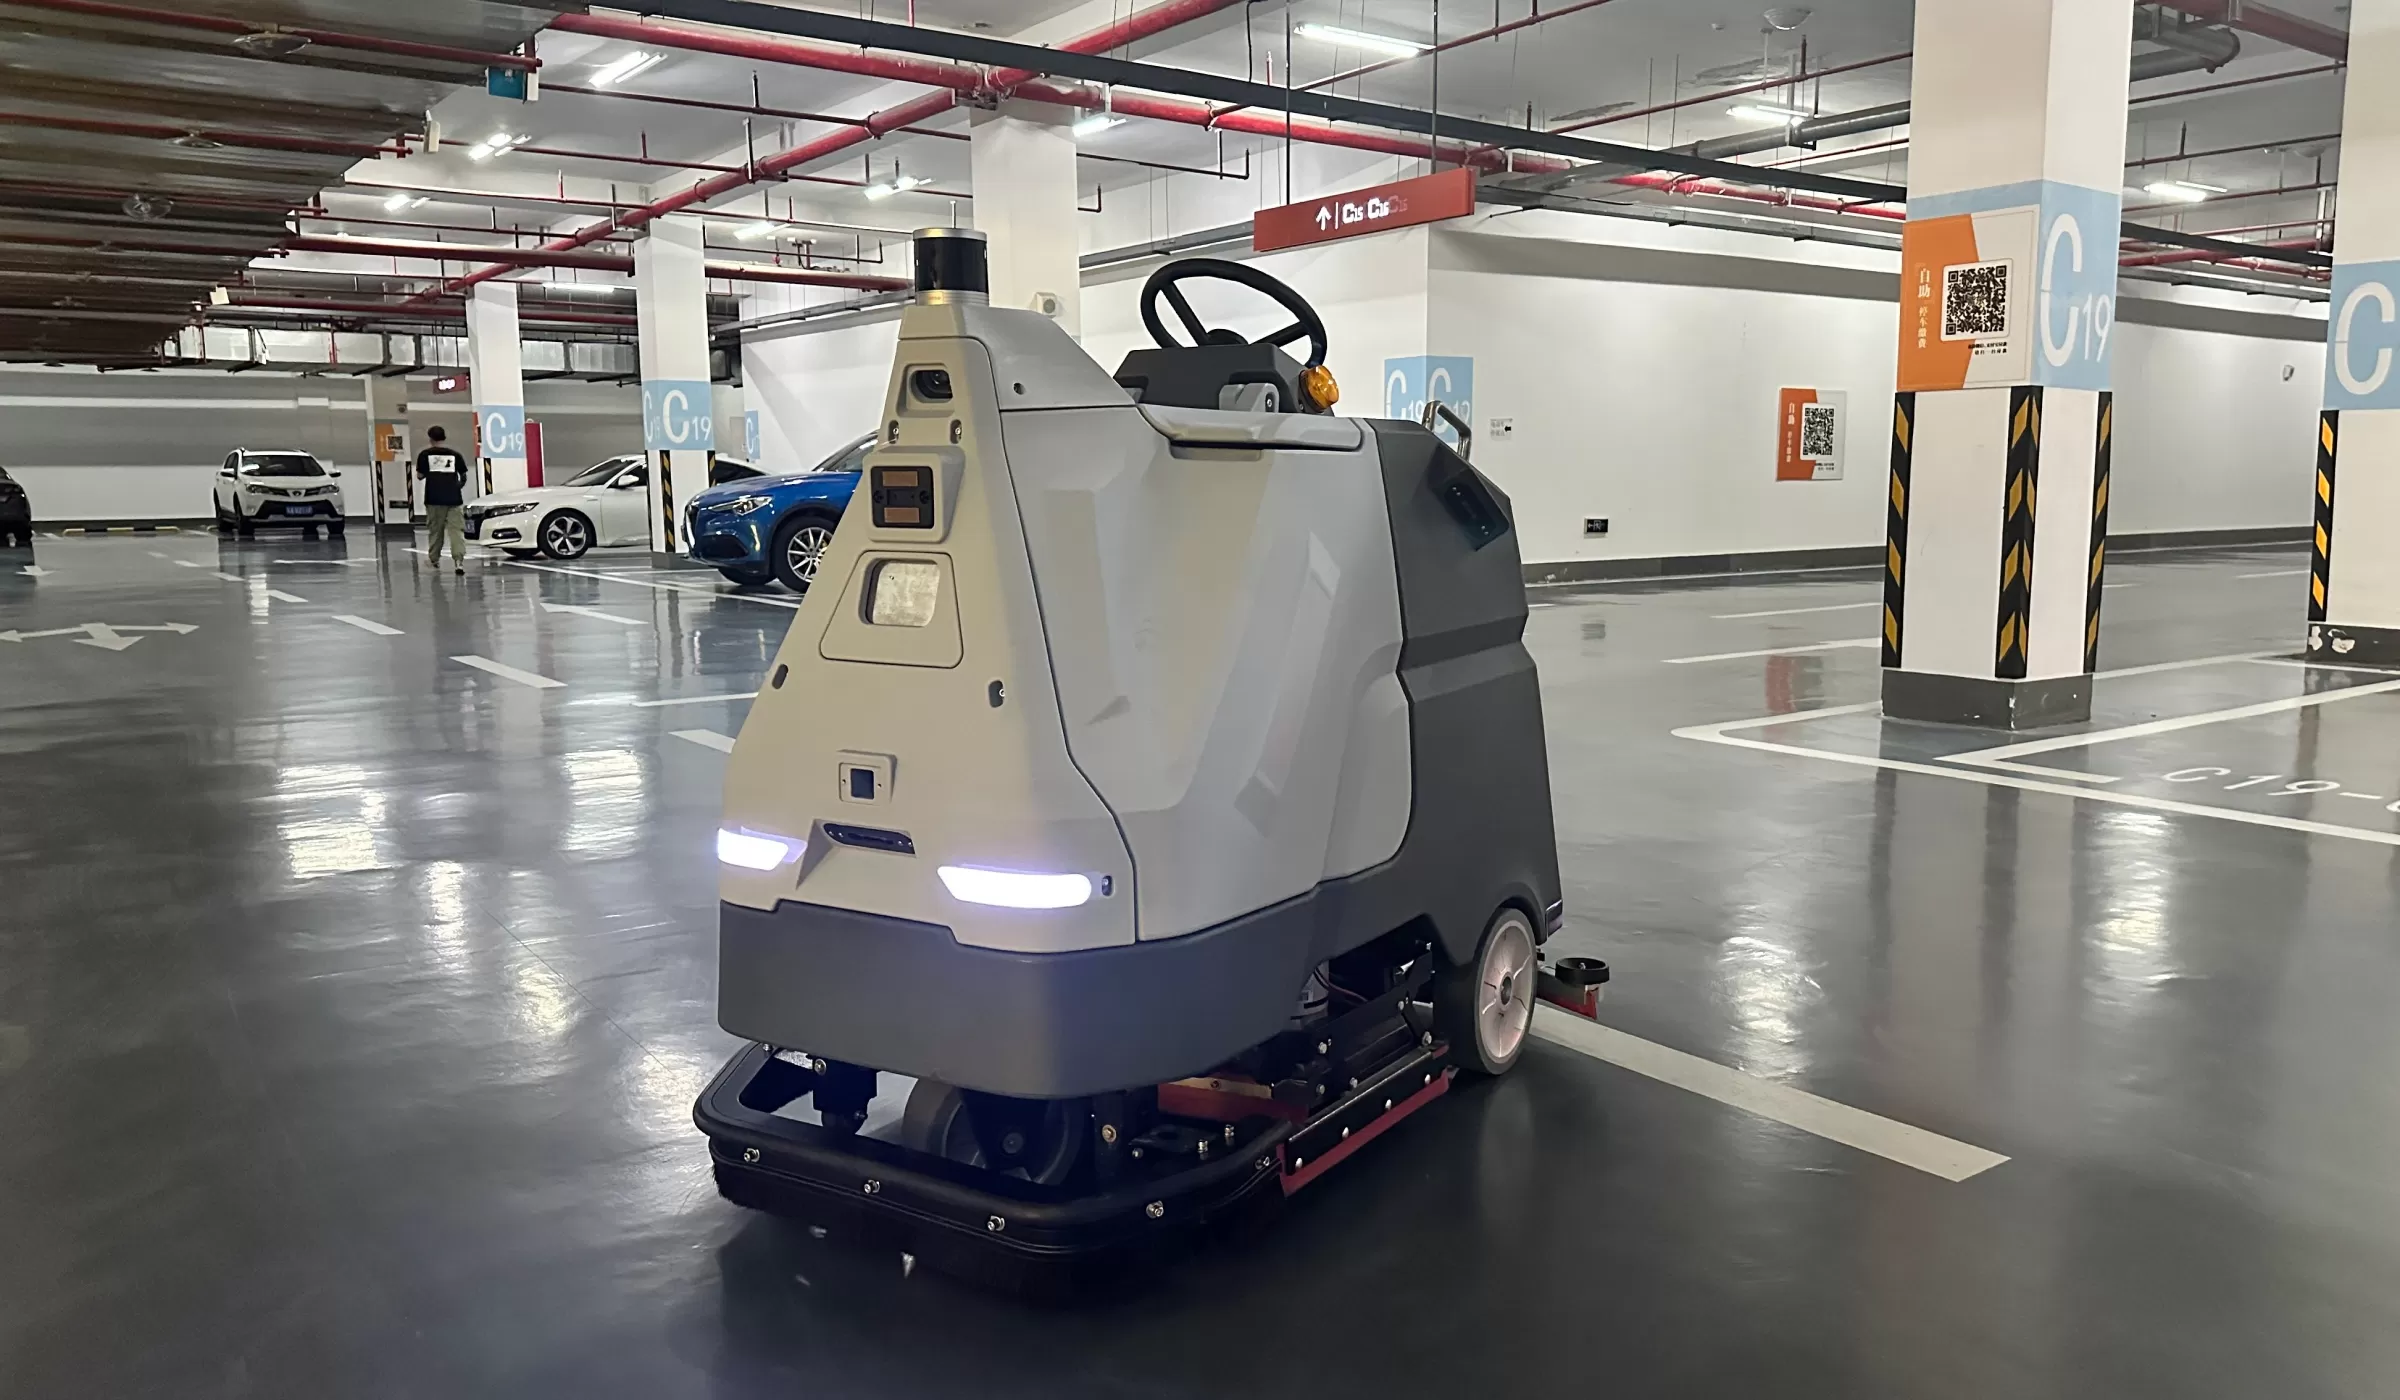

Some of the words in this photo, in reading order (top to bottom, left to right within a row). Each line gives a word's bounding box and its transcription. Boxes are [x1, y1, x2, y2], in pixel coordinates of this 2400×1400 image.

[2040, 213, 2112, 367] C19
[485, 412, 524, 453] C19
[662, 389, 711, 443] C19
[2161, 766, 2400, 812] C19-
